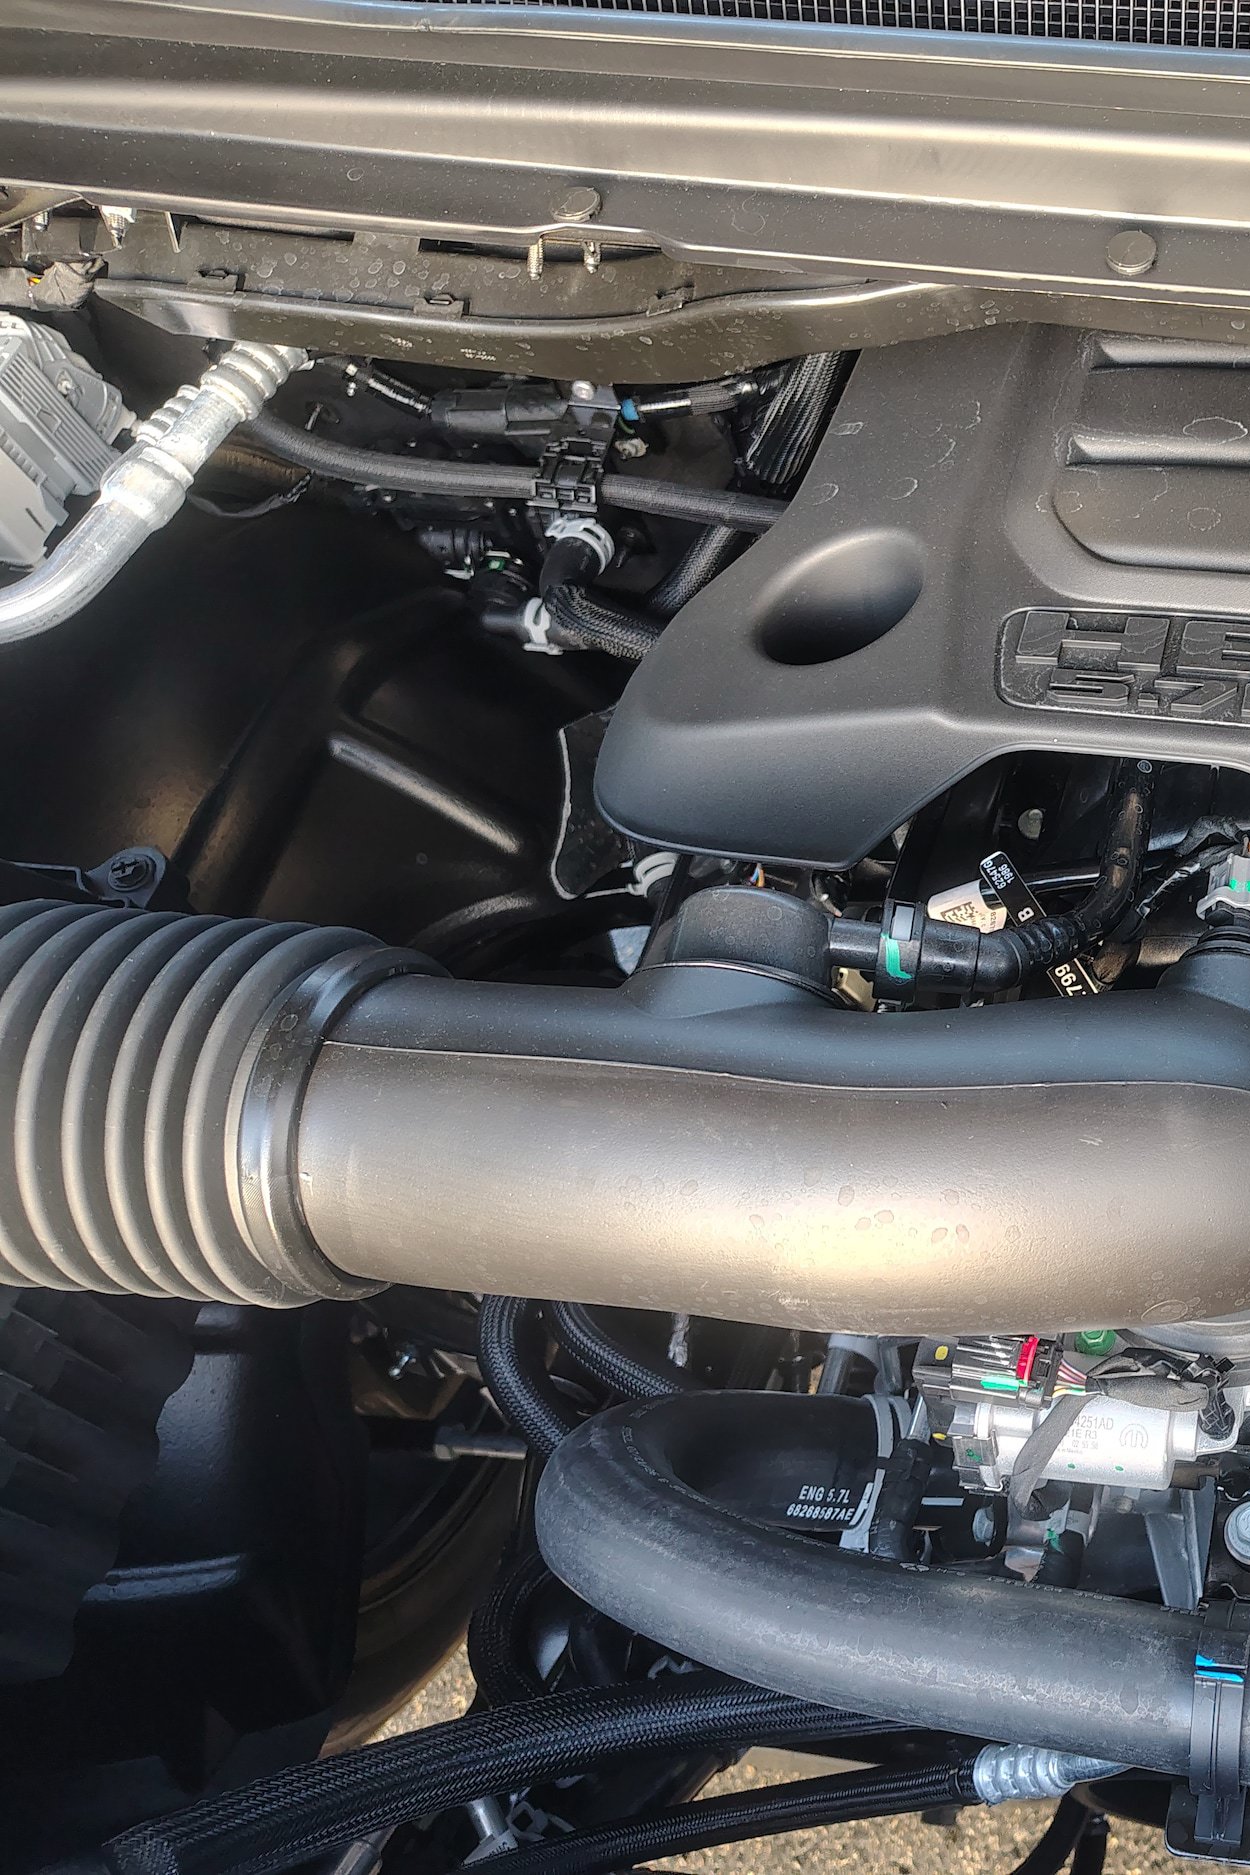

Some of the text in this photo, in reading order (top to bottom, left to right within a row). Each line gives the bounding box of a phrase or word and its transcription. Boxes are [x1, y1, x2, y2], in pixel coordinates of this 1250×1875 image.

[982, 859, 1007, 890] 62547G
[998, 864, 1014, 885] 1986
[1017, 906, 1035, 923] B
[798, 1485, 851, 1504] ENG 5.7L
[786, 1503, 855, 1521] 68268587AE
